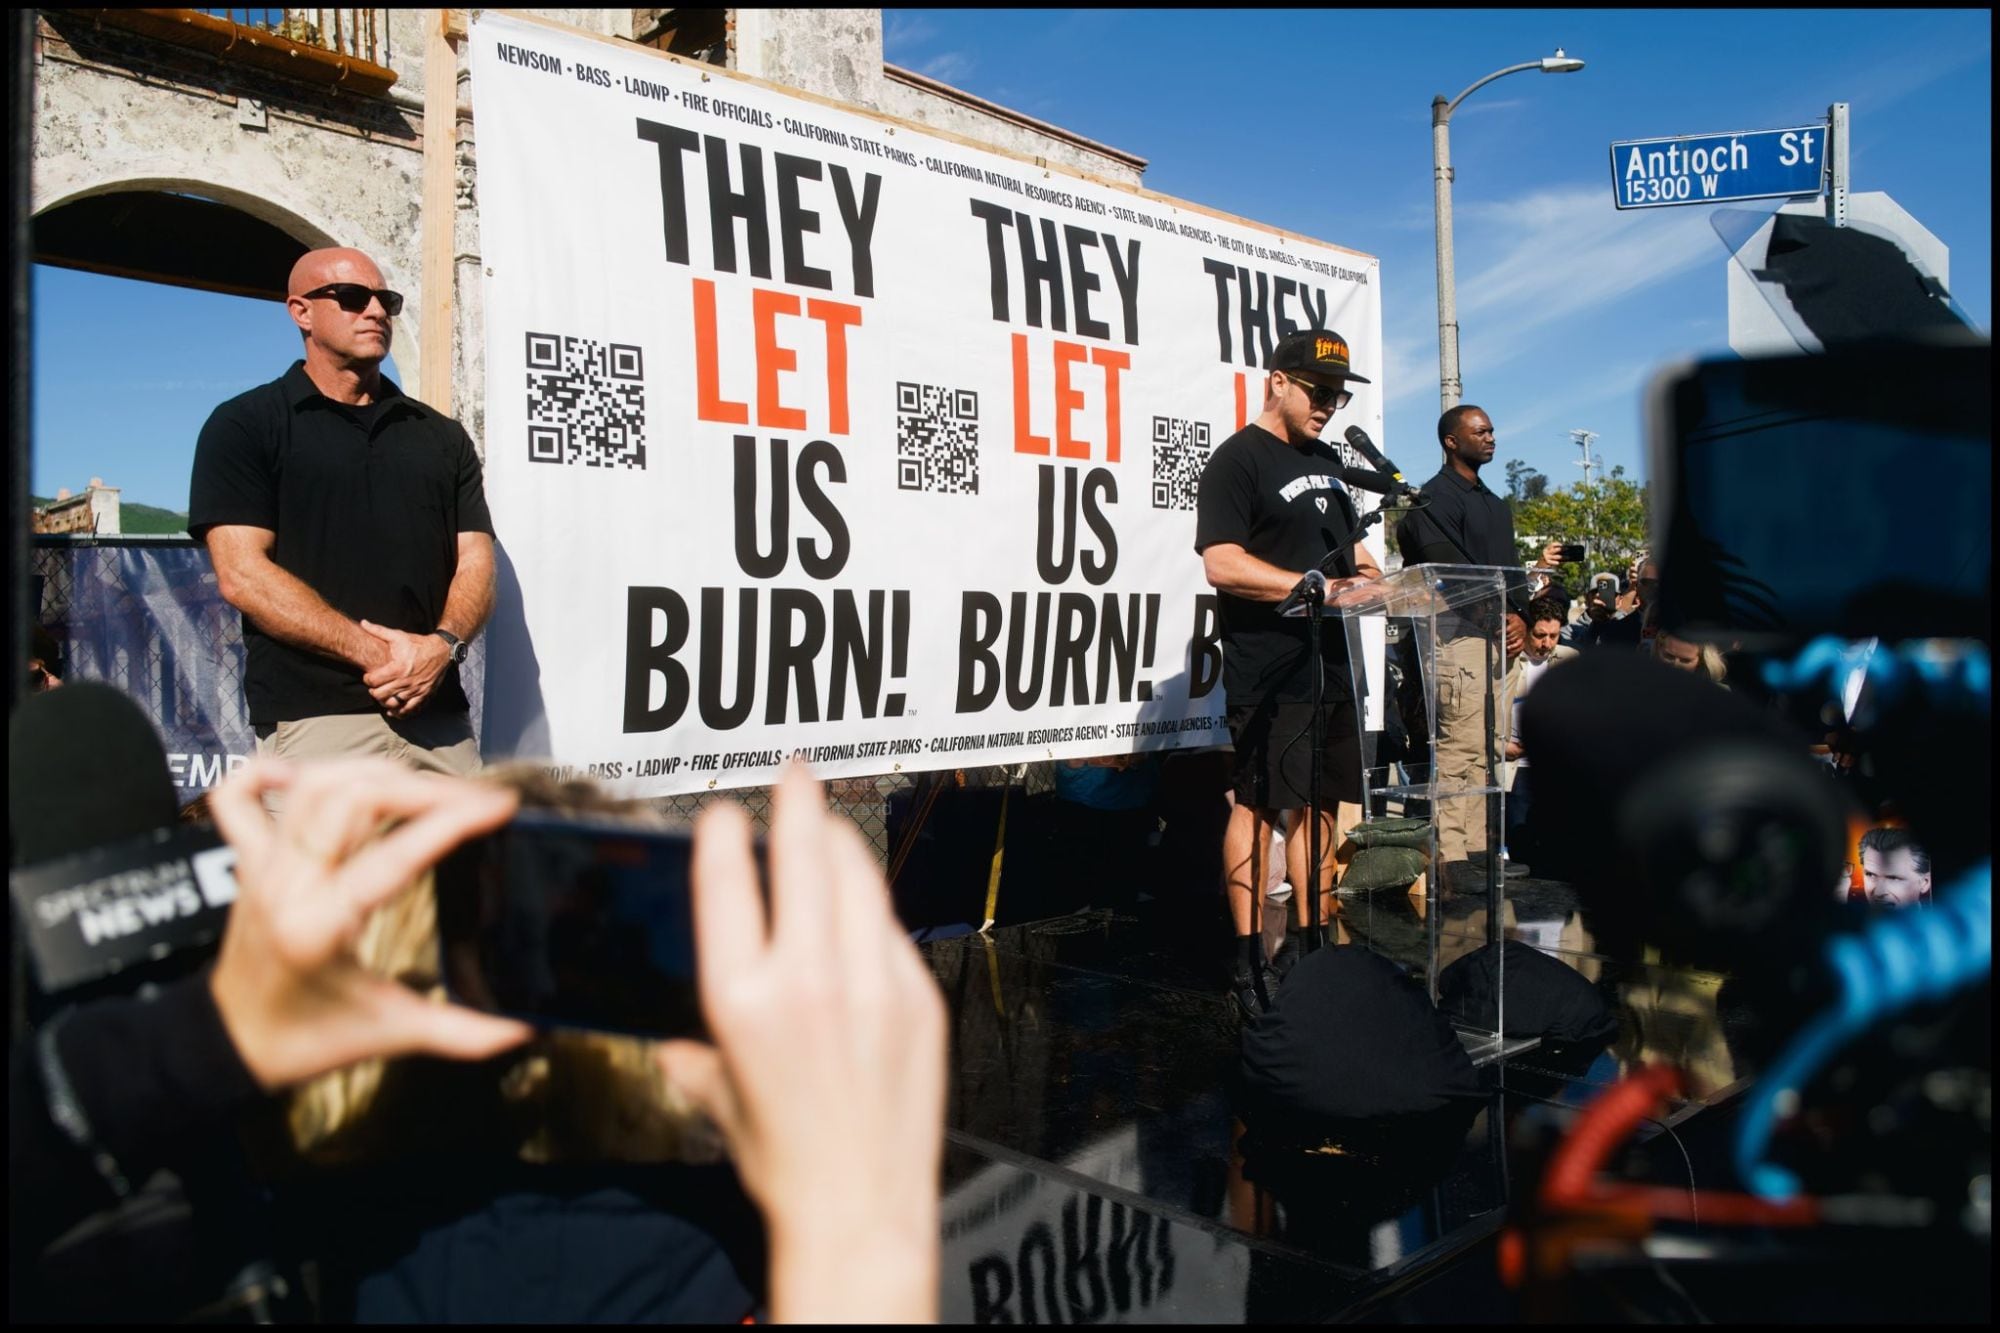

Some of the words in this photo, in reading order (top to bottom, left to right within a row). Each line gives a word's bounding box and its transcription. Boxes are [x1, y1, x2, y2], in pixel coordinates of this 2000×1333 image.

[496, 42, 562, 76] NEWSOM
[576, 63, 611, 88] BASS
[624, 76, 670, 102] LADWP
[682, 91, 709, 113] FIRE
[713, 98, 773, 129] OFFICIALS
[784, 117, 849, 148] CALIFORNIA
[850, 135, 882, 157] STATE
[884, 145, 917, 168] PARKS
[926, 156, 984, 182] CALIFORNIA
[984, 171, 1023, 195] NATURAL
[1025, 182, 1073, 209] RESOURCES
[1075, 196, 1107, 216] AGENCY
[1114, 206, 1138, 224] STATE
[1138, 213, 1154, 228] AND
[1154, 218, 1179, 235] LOCAL
[1179, 224, 1212, 244] AGENCIES
[1217, 235, 1231, 249] THE
[1231, 238, 1245, 252] CITY
[1246, 242, 1254, 256] OF
[1254, 246, 1268, 259] LOS
[1269, 249, 1298, 267] ANGELES
[1300, 258, 1313, 272] THE
[1313, 261, 1330, 277] STATE
[1331, 265, 1338, 278] OF
[635, 117, 882, 298] THEY
[1626, 138, 1748, 179] Antioch
[1779, 131, 1815, 166] St
[1626, 176, 1690, 203] 15300
[1701, 174, 1718, 197] W
[969, 198, 1142, 345] THEY
[1202, 257, 1327, 369] THEY
[691, 277, 862, 435] LET
[1011, 333, 1131, 463] LET
[733, 435, 850, 580] US
[1036, 464, 1119, 585] US
[622, 586, 911, 734] BURN!
[955, 591, 1161, 714] BURN!
[588, 761, 623, 780] BASS
[636, 757, 681, 777] LADWP
[691, 754, 720, 772] FIRE
[722, 749, 782, 769] OFFICIALS
[792, 744, 855, 764] CALIFORNIA
[856, 741, 889, 759] STATE
[890, 738, 922, 755] PARKS
[930, 733, 986, 753] CALIFORNIA
[986, 731, 1025, 748] NATURAL
[1027, 727, 1073, 746] RESOURCES
[1075, 724, 1108, 741] AGENCY
[1116, 723, 1138, 738] STATE
[1140, 721, 1155, 736] AND
[1155, 720, 1179, 735] LOCAL
[1179, 716, 1212, 732] AGENCIES
[1219, 715, 1229, 729] TH
[78, 880, 202, 946] NEWS
